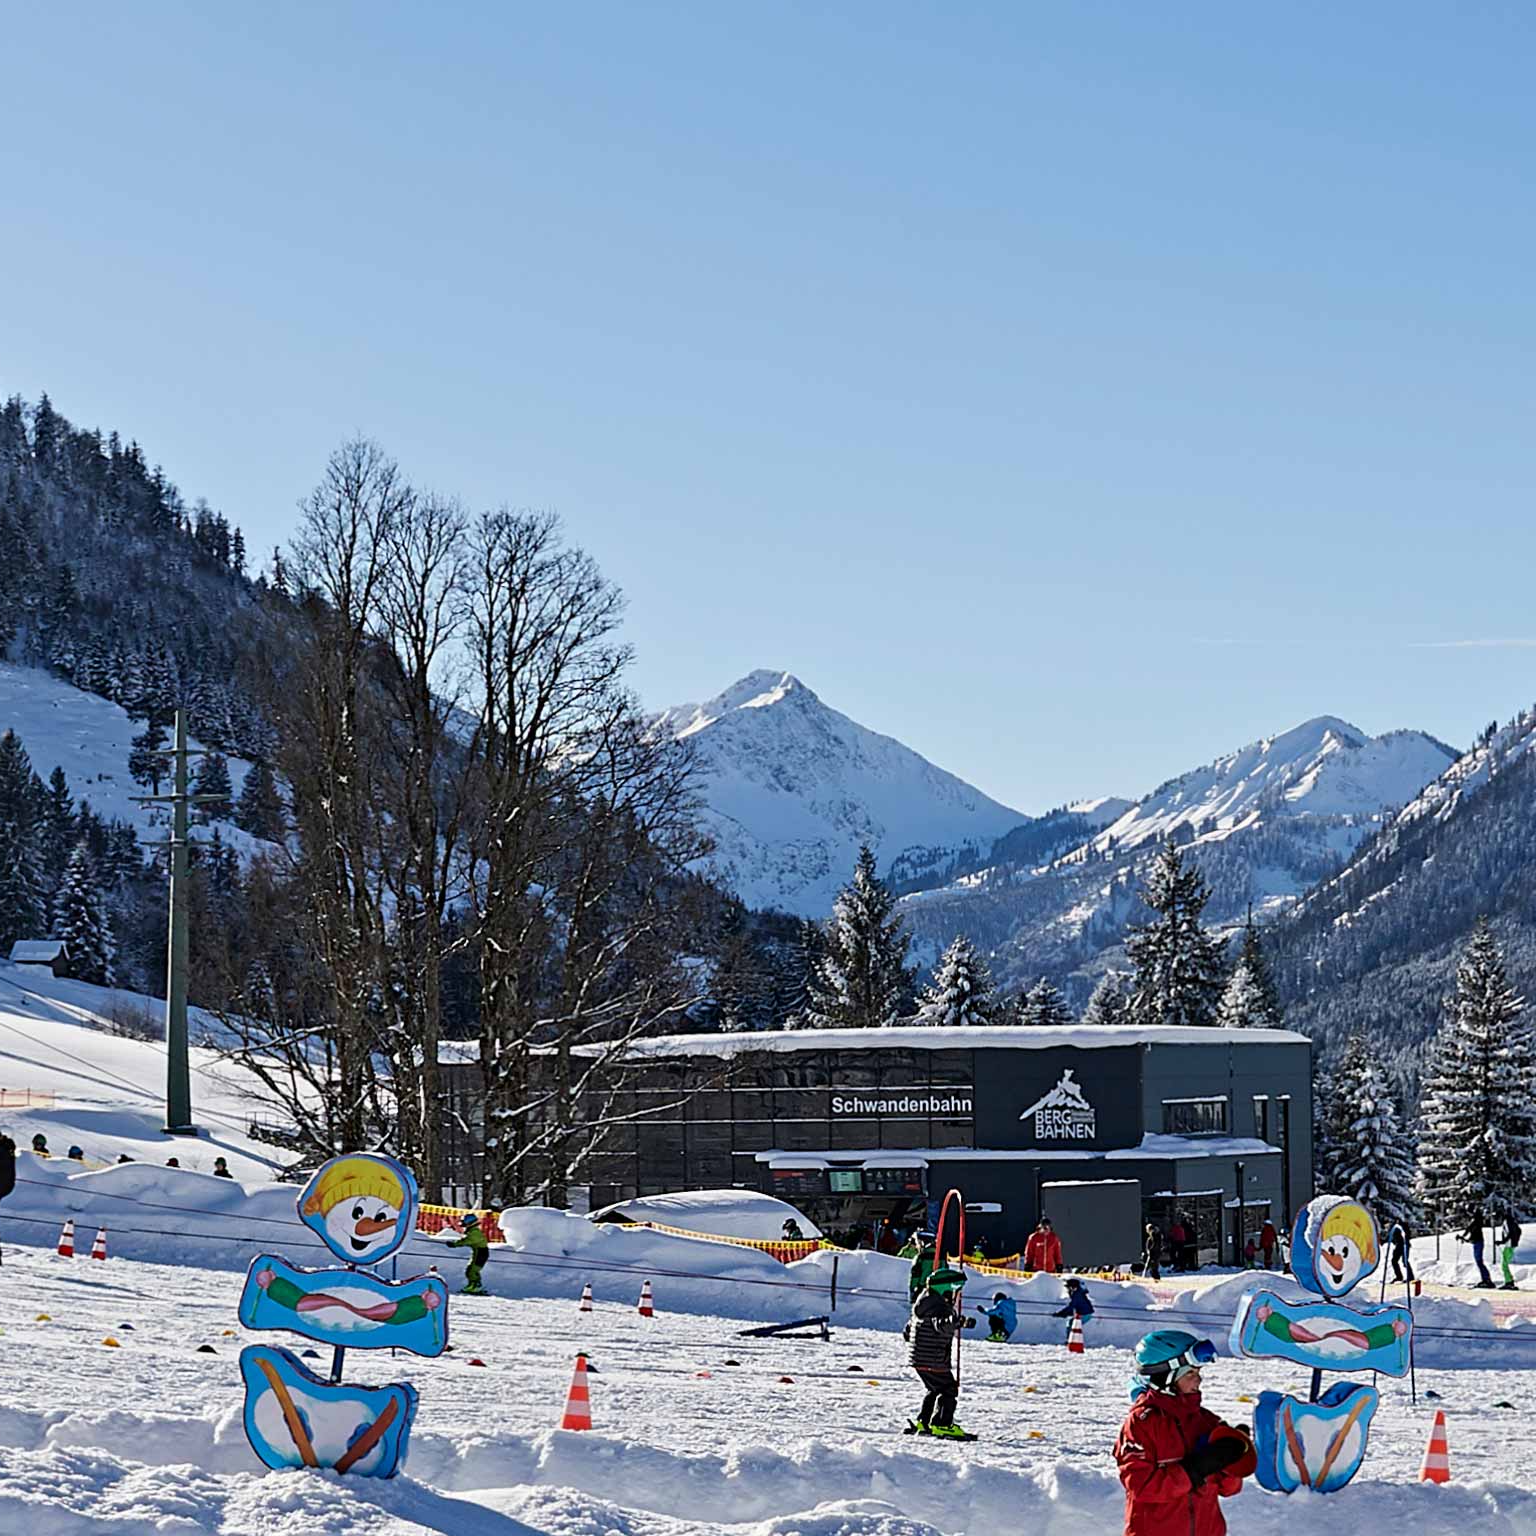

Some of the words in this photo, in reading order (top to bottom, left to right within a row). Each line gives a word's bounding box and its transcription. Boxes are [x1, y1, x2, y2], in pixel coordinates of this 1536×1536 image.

[831, 1096, 972, 1113] Schwandenbahn
[1035, 1110, 1071, 1125] BERG
[1035, 1125, 1095, 1139] BAHNEN
